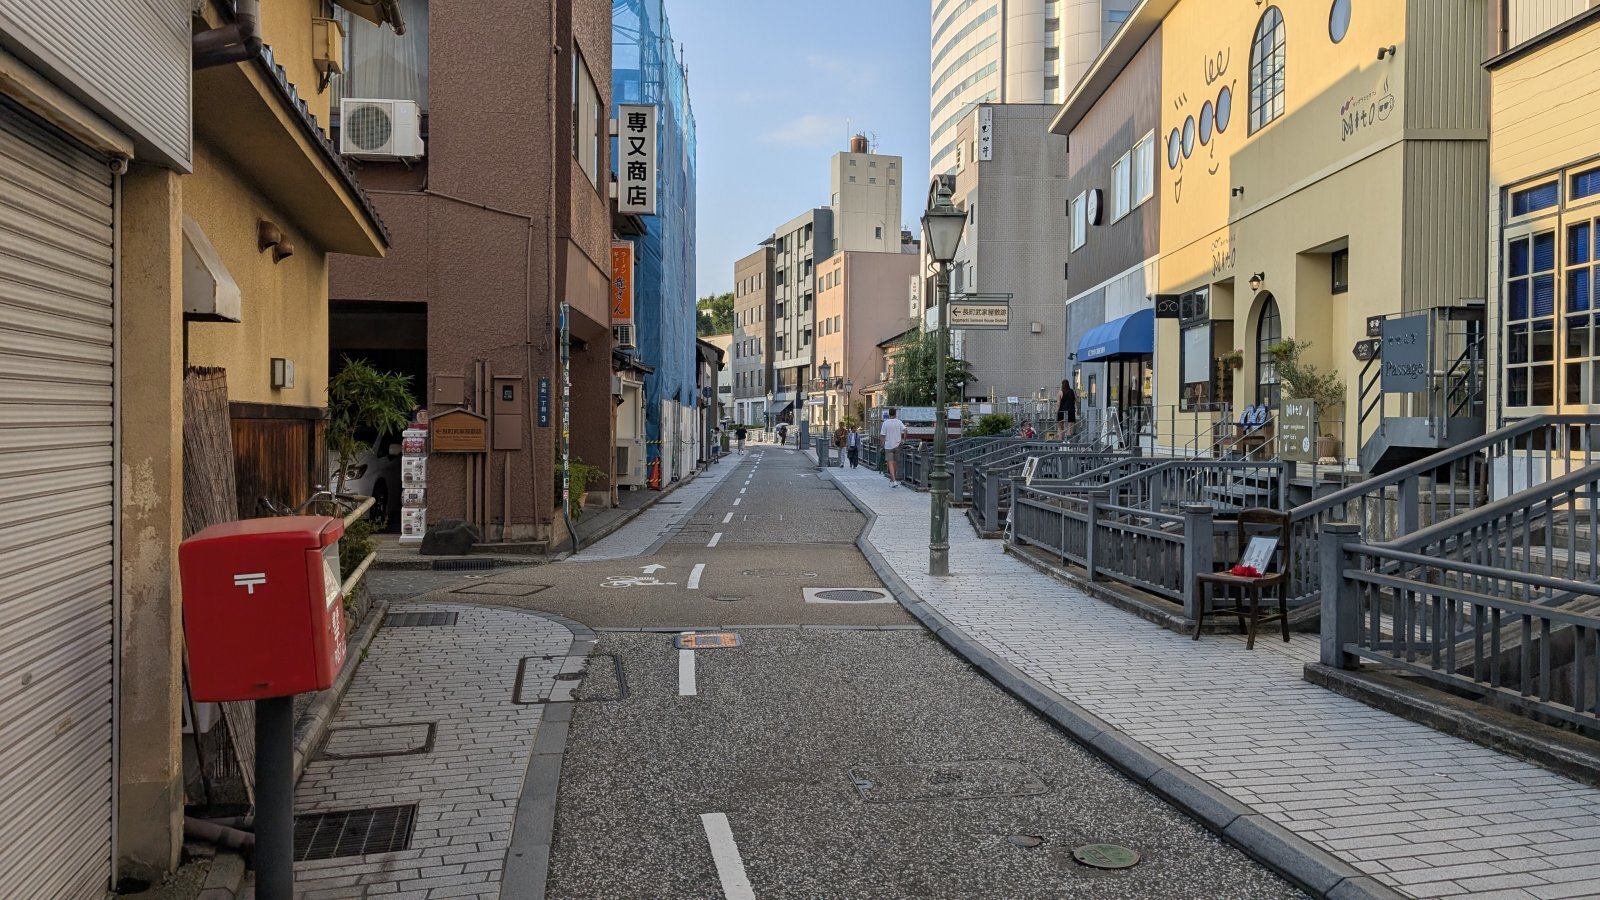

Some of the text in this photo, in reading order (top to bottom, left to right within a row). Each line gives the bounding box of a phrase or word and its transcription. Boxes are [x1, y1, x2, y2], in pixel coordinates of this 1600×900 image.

[627, 112, 647, 206] 専又商店
[1386, 361, 1424, 380] Passage
